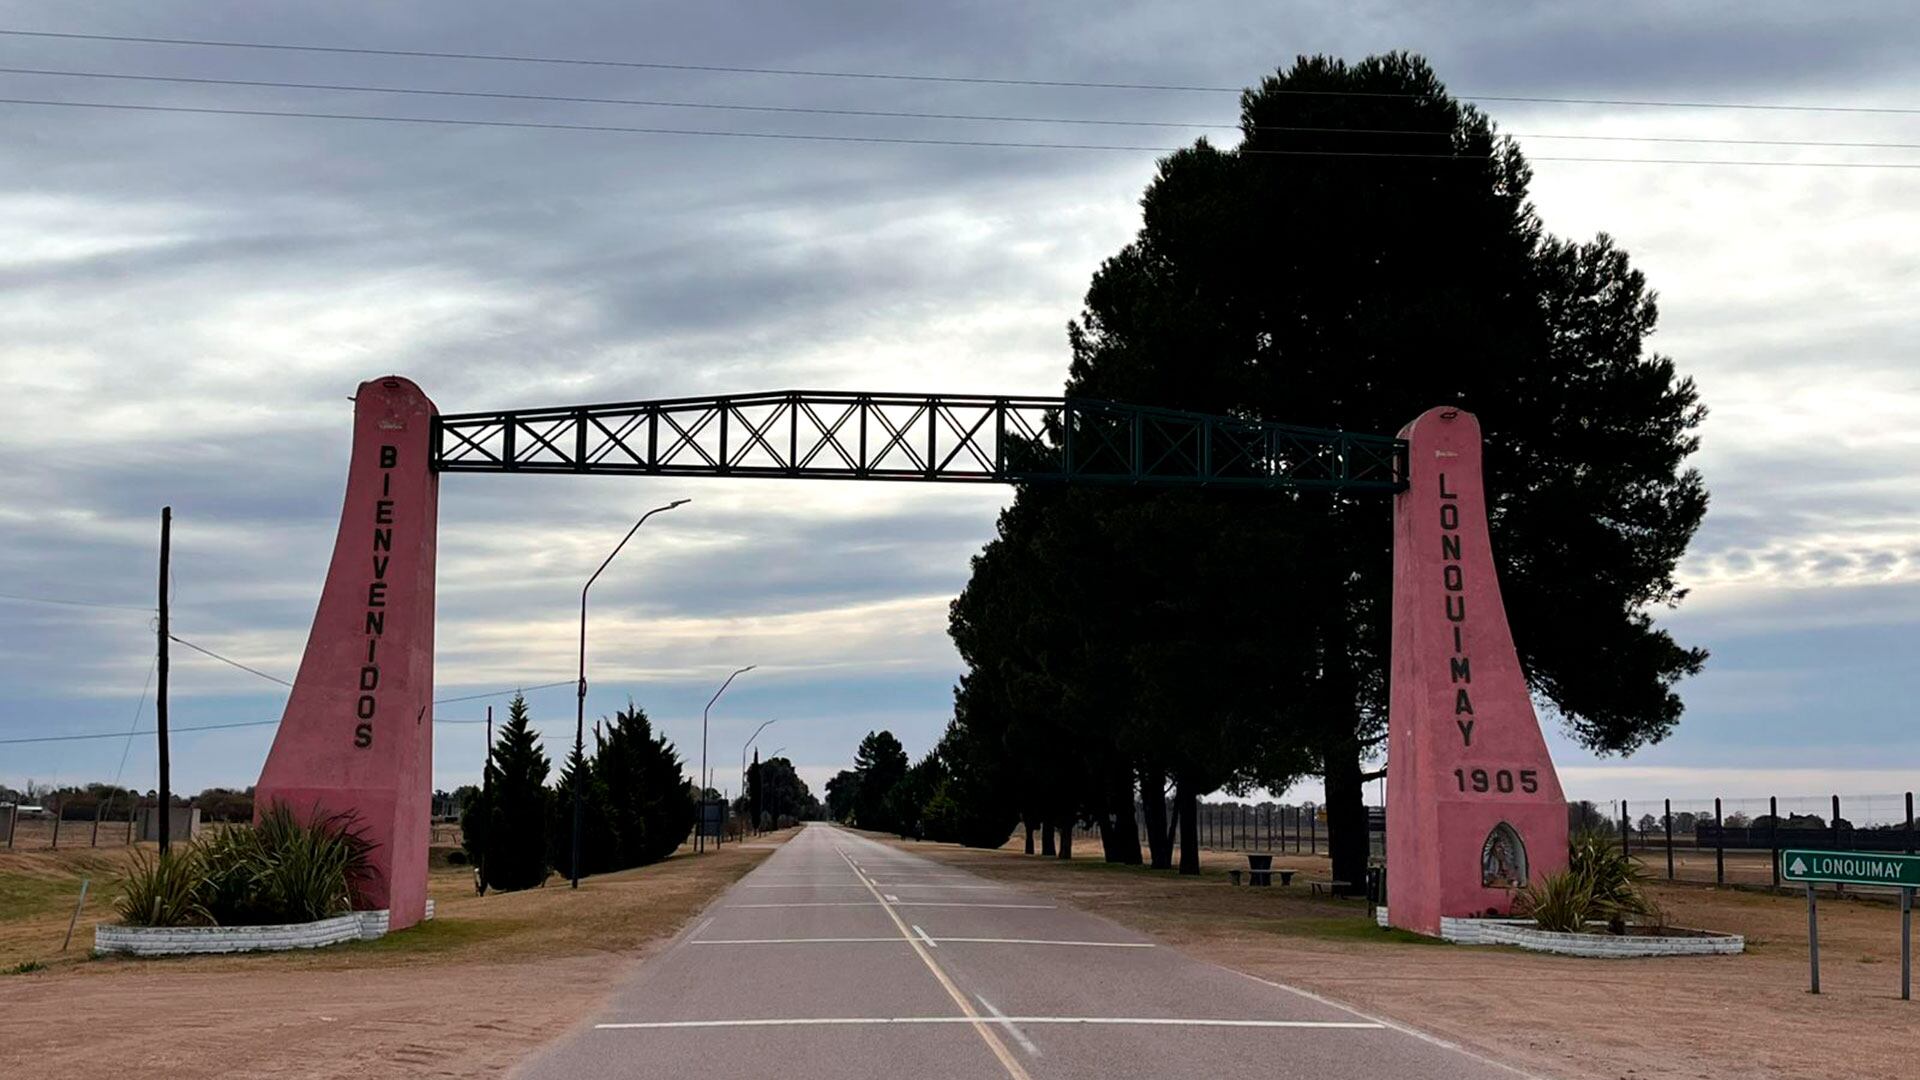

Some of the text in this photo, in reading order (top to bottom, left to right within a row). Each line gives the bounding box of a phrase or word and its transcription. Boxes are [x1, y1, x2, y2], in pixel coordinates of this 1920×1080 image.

[354, 446, 398, 748] BIENVENIDOS
[1455, 769, 1538, 793] 1905
[1813, 858, 1903, 878] LONQUIMAY
